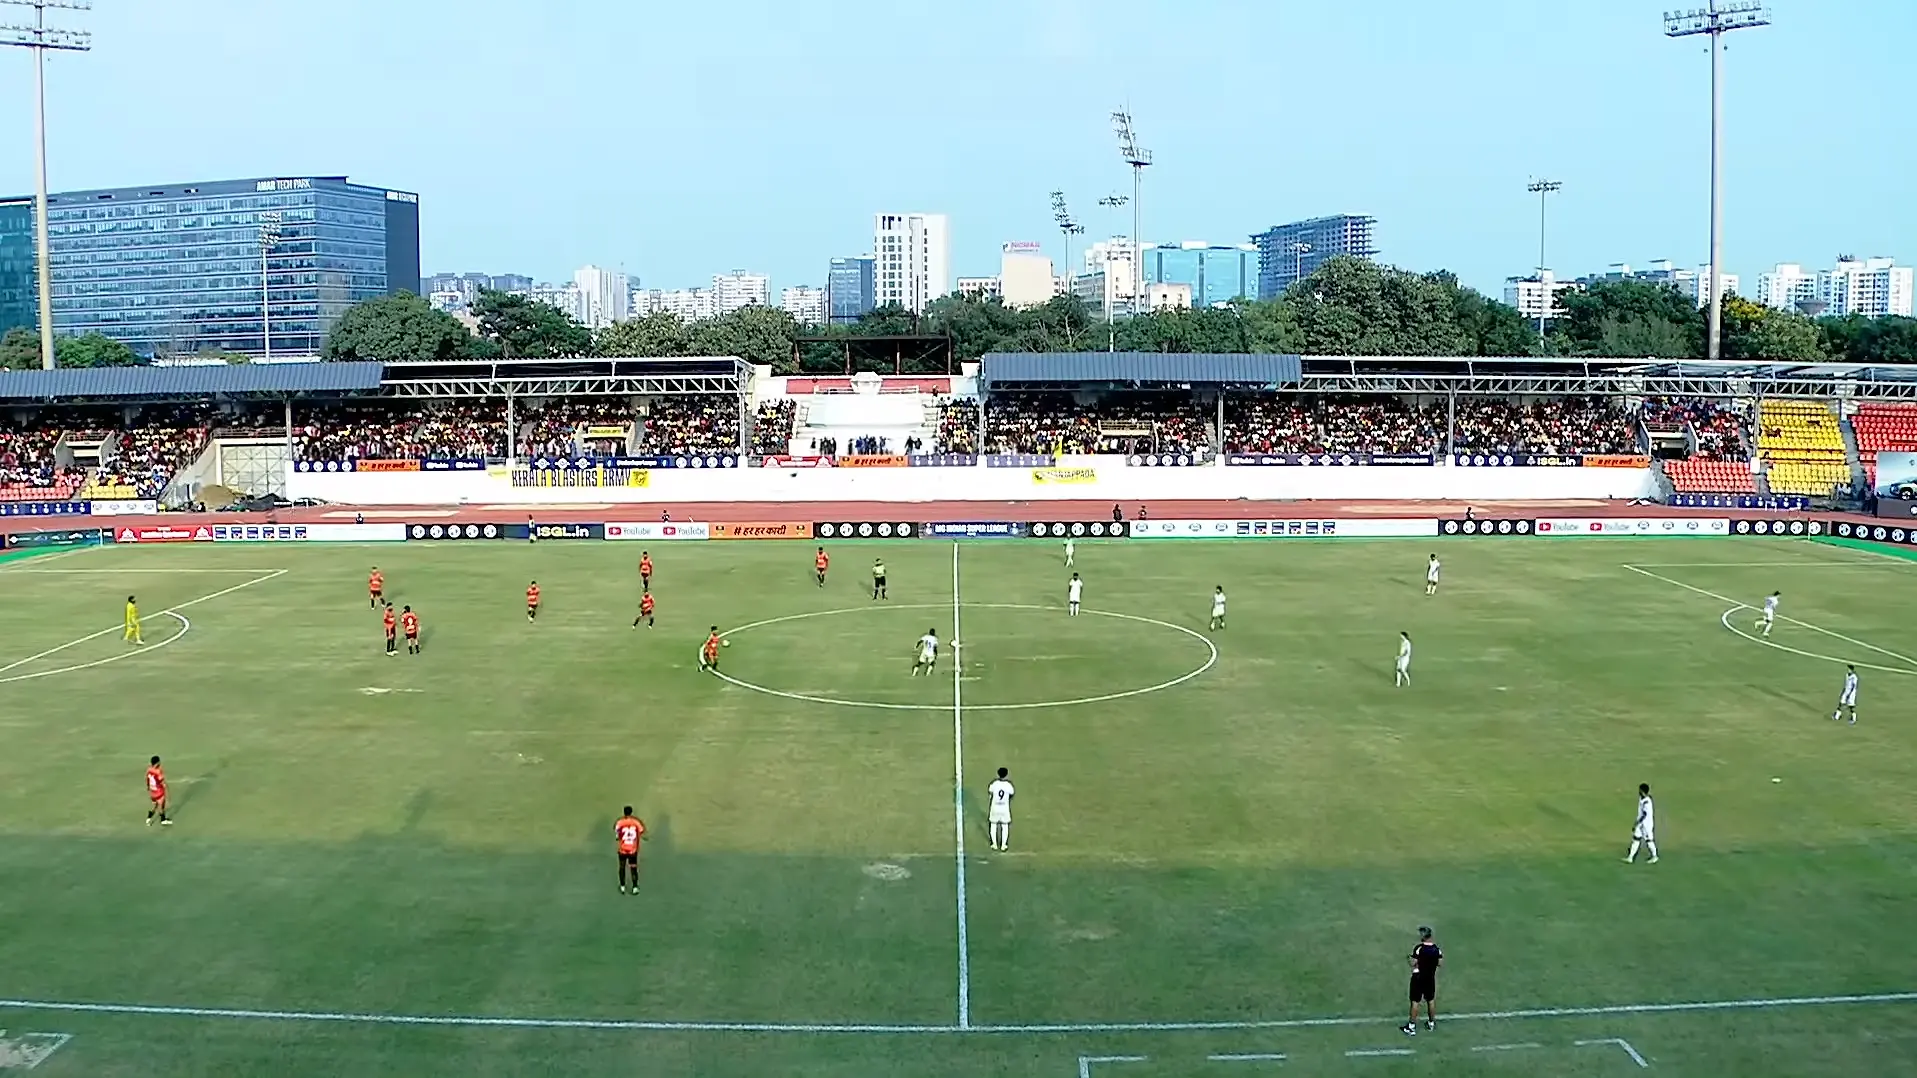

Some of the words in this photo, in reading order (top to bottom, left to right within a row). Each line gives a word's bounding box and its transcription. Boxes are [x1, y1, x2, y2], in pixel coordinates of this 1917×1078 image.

[276, 180, 292, 190] TECH
[293, 178, 311, 189] PARK
[512, 469, 547, 487] KERALA
[551, 468, 598, 487] BLASTERS
[602, 468, 630, 487] ARMY
[623, 526, 650, 536] YouTube
[678, 526, 706, 536] YouTube
[966, 523, 987, 533] SUPER
[987, 524, 1008, 533] LEAGUE
[1553, 521, 1579, 532] YouTube
[1604, 521, 1630, 532] YouTube
[998, 789, 1005, 800] 9
